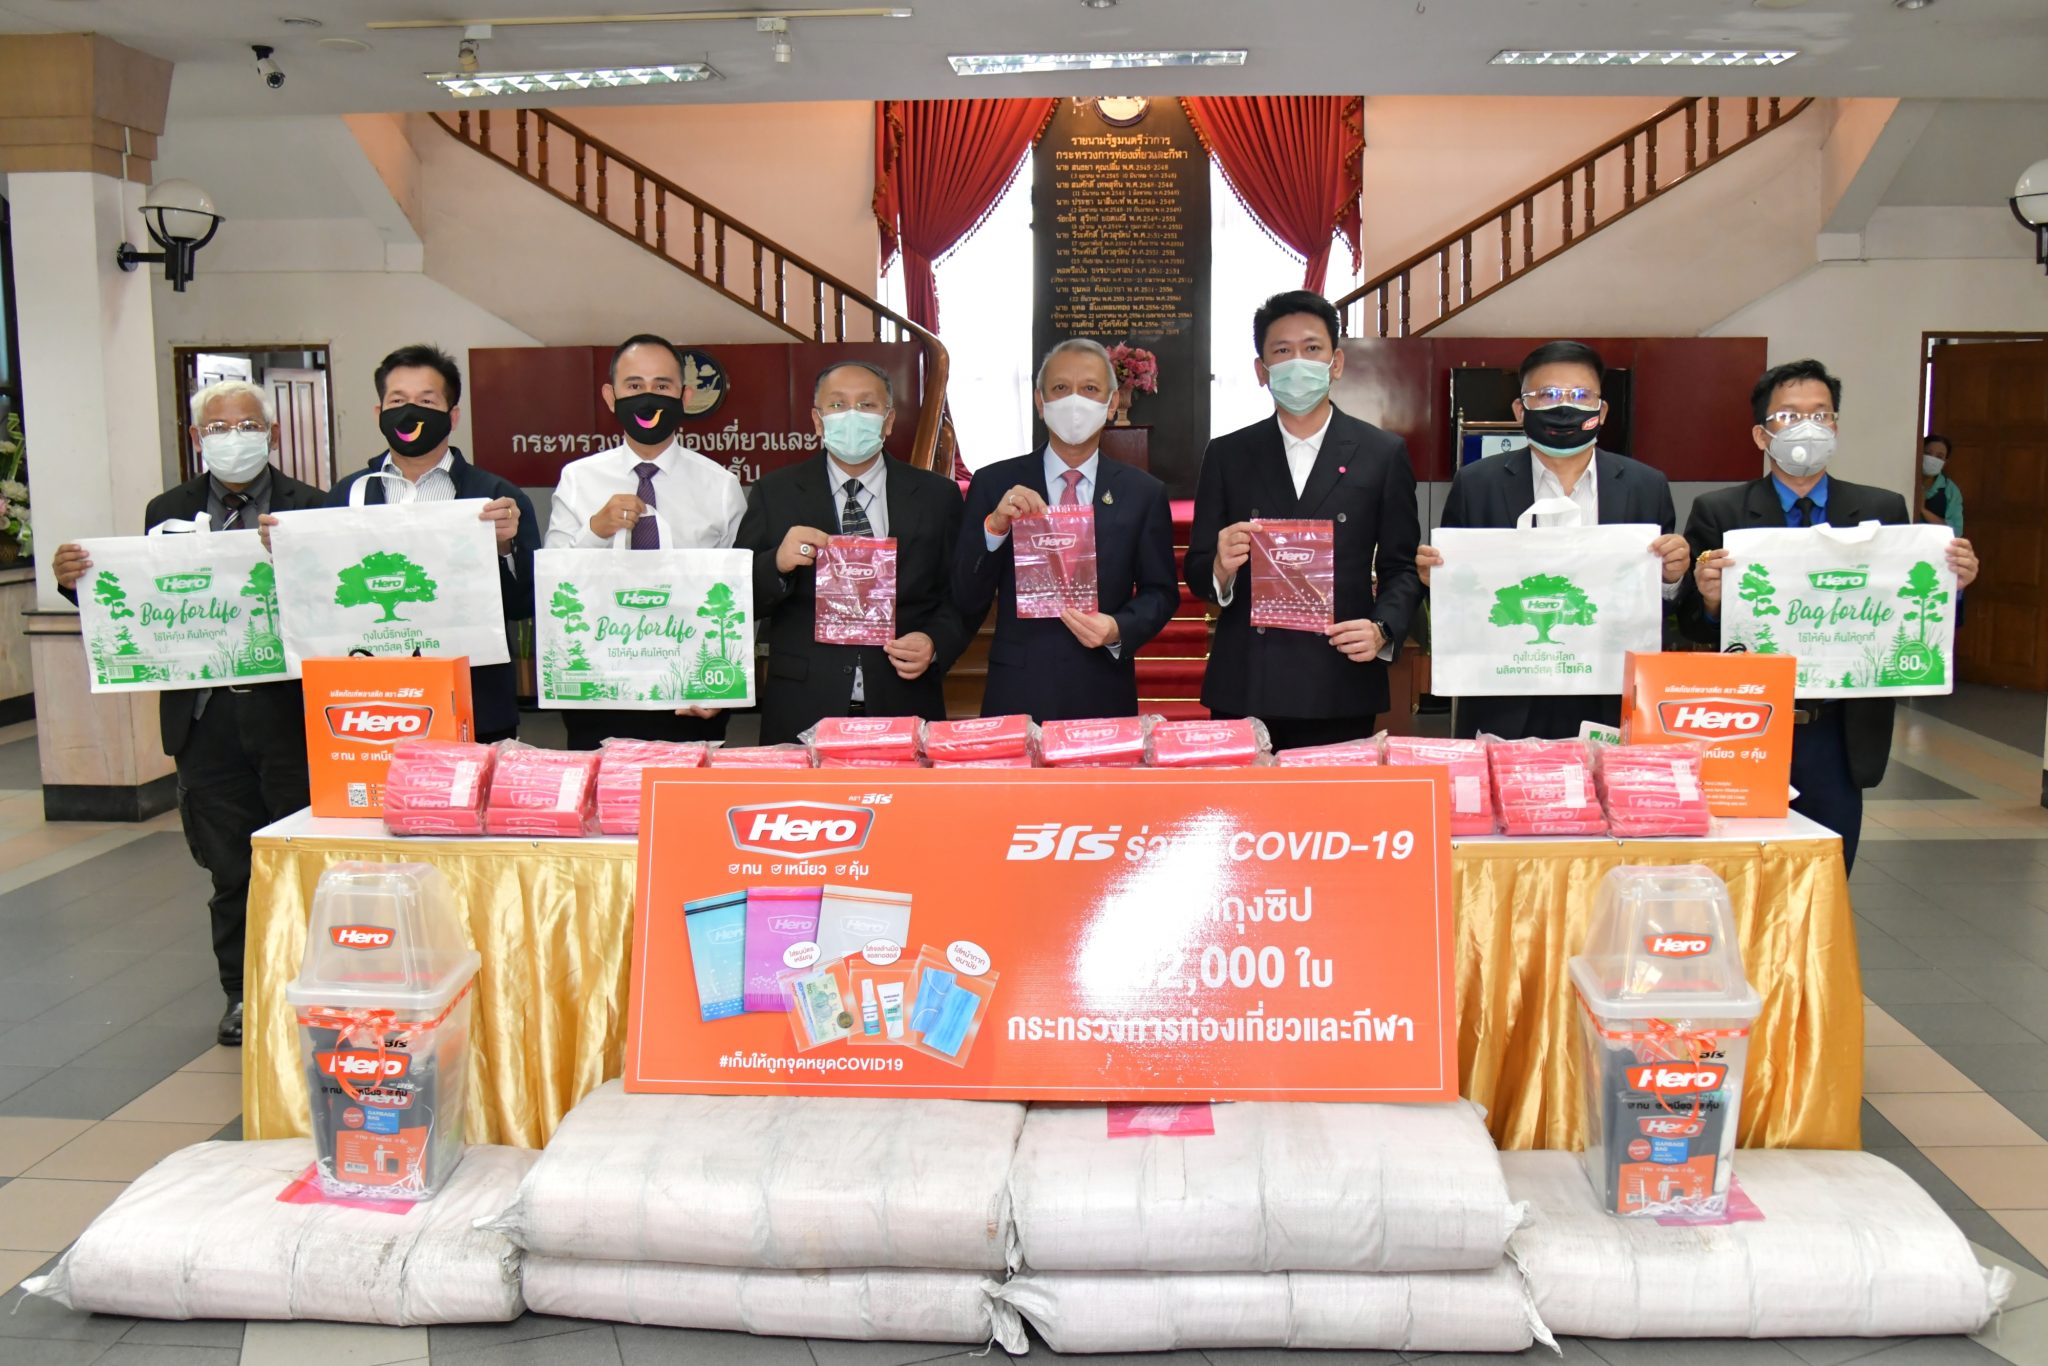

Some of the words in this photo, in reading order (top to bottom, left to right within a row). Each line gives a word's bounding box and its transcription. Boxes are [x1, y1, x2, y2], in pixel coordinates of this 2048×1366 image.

[1071, 134, 1170, 148] รายนามรัฐมนตรีว่าการ
[1056, 147, 1188, 160] กระทรวงการท่องเที่ยวและกีฬา
[163, 576, 207, 591] Hero
[372, 580, 401, 588] Hero
[1816, 573, 1864, 587] Hero
[621, 593, 665, 606] Hero
[1527, 600, 1560, 609] Hero
[140, 602, 177, 629] Bag
[177, 598, 208, 627] for
[208, 597, 242, 625] life
[1785, 598, 1825, 629] Bag
[1826, 596, 1858, 627] for
[1858, 596, 1894, 627] life
[594, 616, 633, 645] Bag
[633, 615, 667, 642] for
[667, 615, 697, 644] life
[341, 711, 421, 732] Hero
[847, 719, 888, 733] Hero
[957, 718, 1000, 732] Hero
[1673, 707, 1760, 729] Hero
[1185, 728, 1228, 742] Hero
[340, 753, 355, 761] ทน
[1751, 747, 1767, 763] คุ้ม
[748, 813, 857, 842] Hero
[1006, 823, 1123, 861] ฮีโร่
[1228, 830, 1415, 862] COVID-19
[742, 863, 762, 875] ทน
[785, 861, 827, 876] เหนียว
[848, 860, 869, 880] คุ้ม
[775, 918, 813, 931] Hero
[339, 929, 388, 945] Hero
[1653, 937, 1706, 952] Hero
[1294, 946, 1333, 988] ใบ
[1007, 1000, 1415, 1042] กระทรวงการท่องเที่ยวและกีฬา
[329, 1055, 402, 1075] Hero
[719, 1050, 904, 1075] #เก็บให้ถูกจุดหยุดCOVID19
[1638, 1069, 1717, 1087] Hero
[1647, 1120, 1699, 1134] Heo
